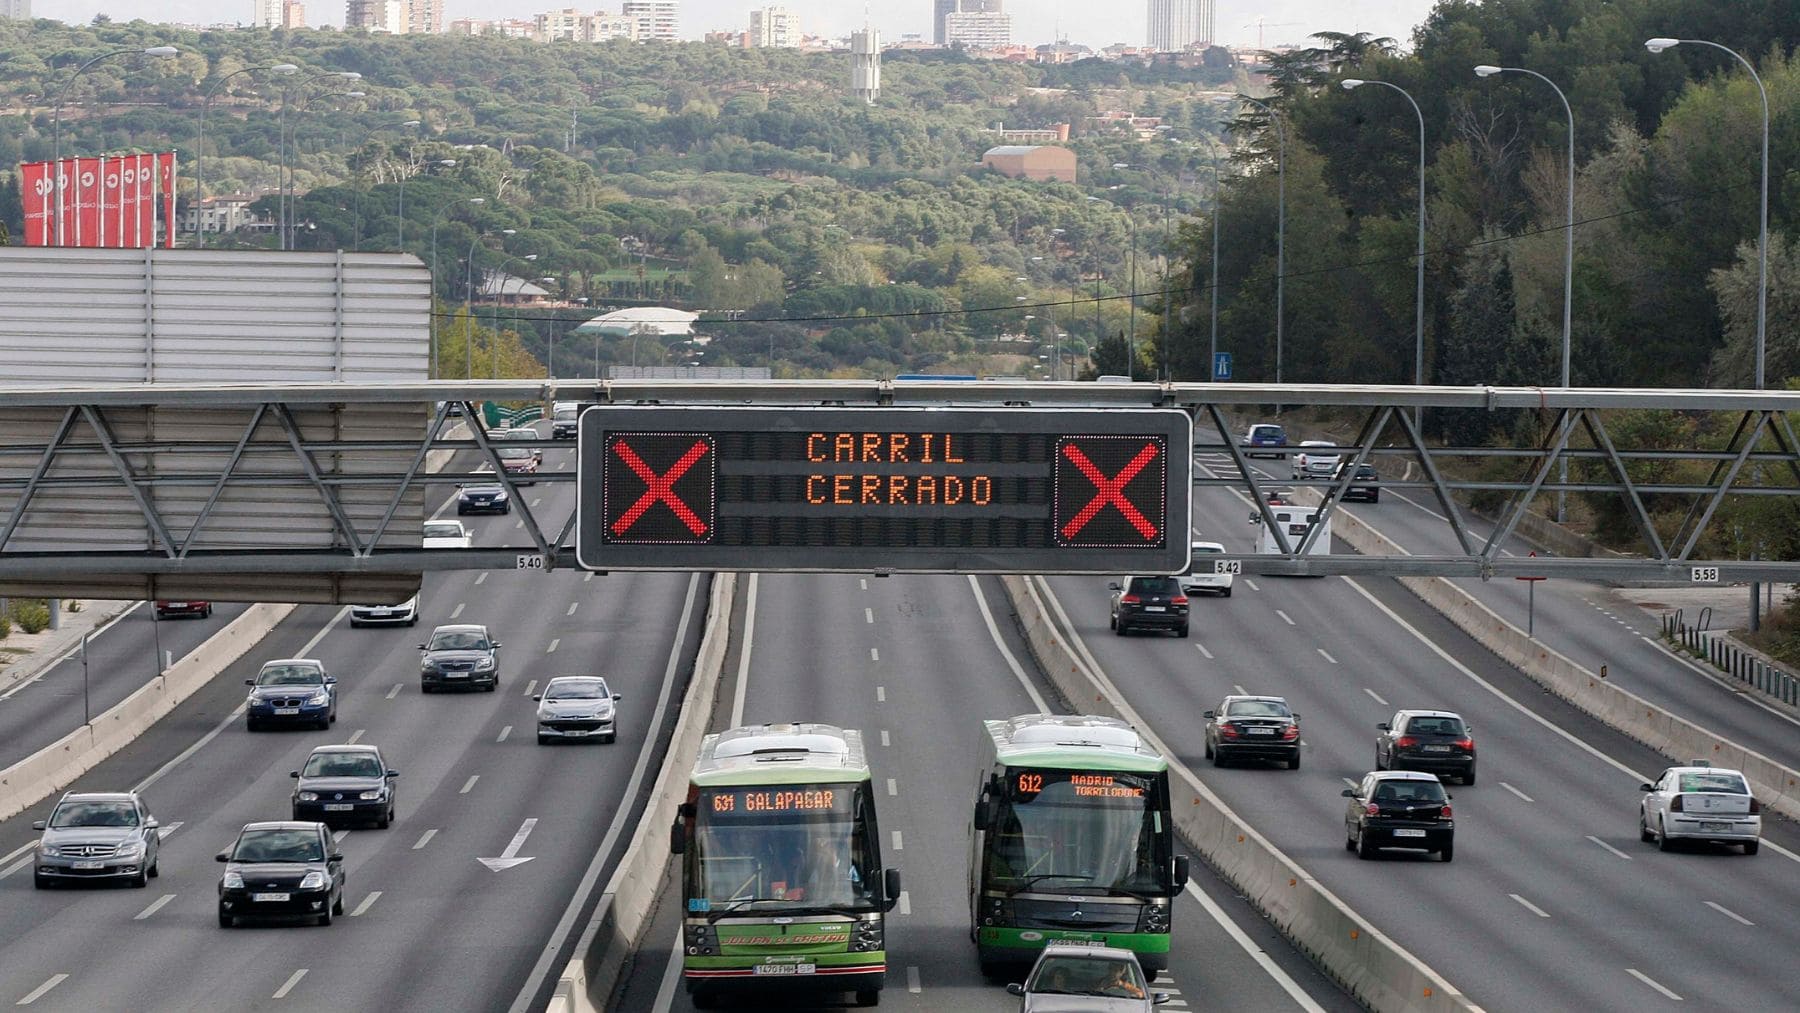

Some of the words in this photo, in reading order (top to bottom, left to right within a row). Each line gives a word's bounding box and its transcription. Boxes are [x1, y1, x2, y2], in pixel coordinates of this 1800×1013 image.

[807, 433, 963, 463] CARRIL
[807, 475, 991, 505] CERRADO
[1019, 774, 1042, 792] 612
[1071, 775, 1114, 786] MADRID
[745, 790, 833, 811] GALAPAGAR
